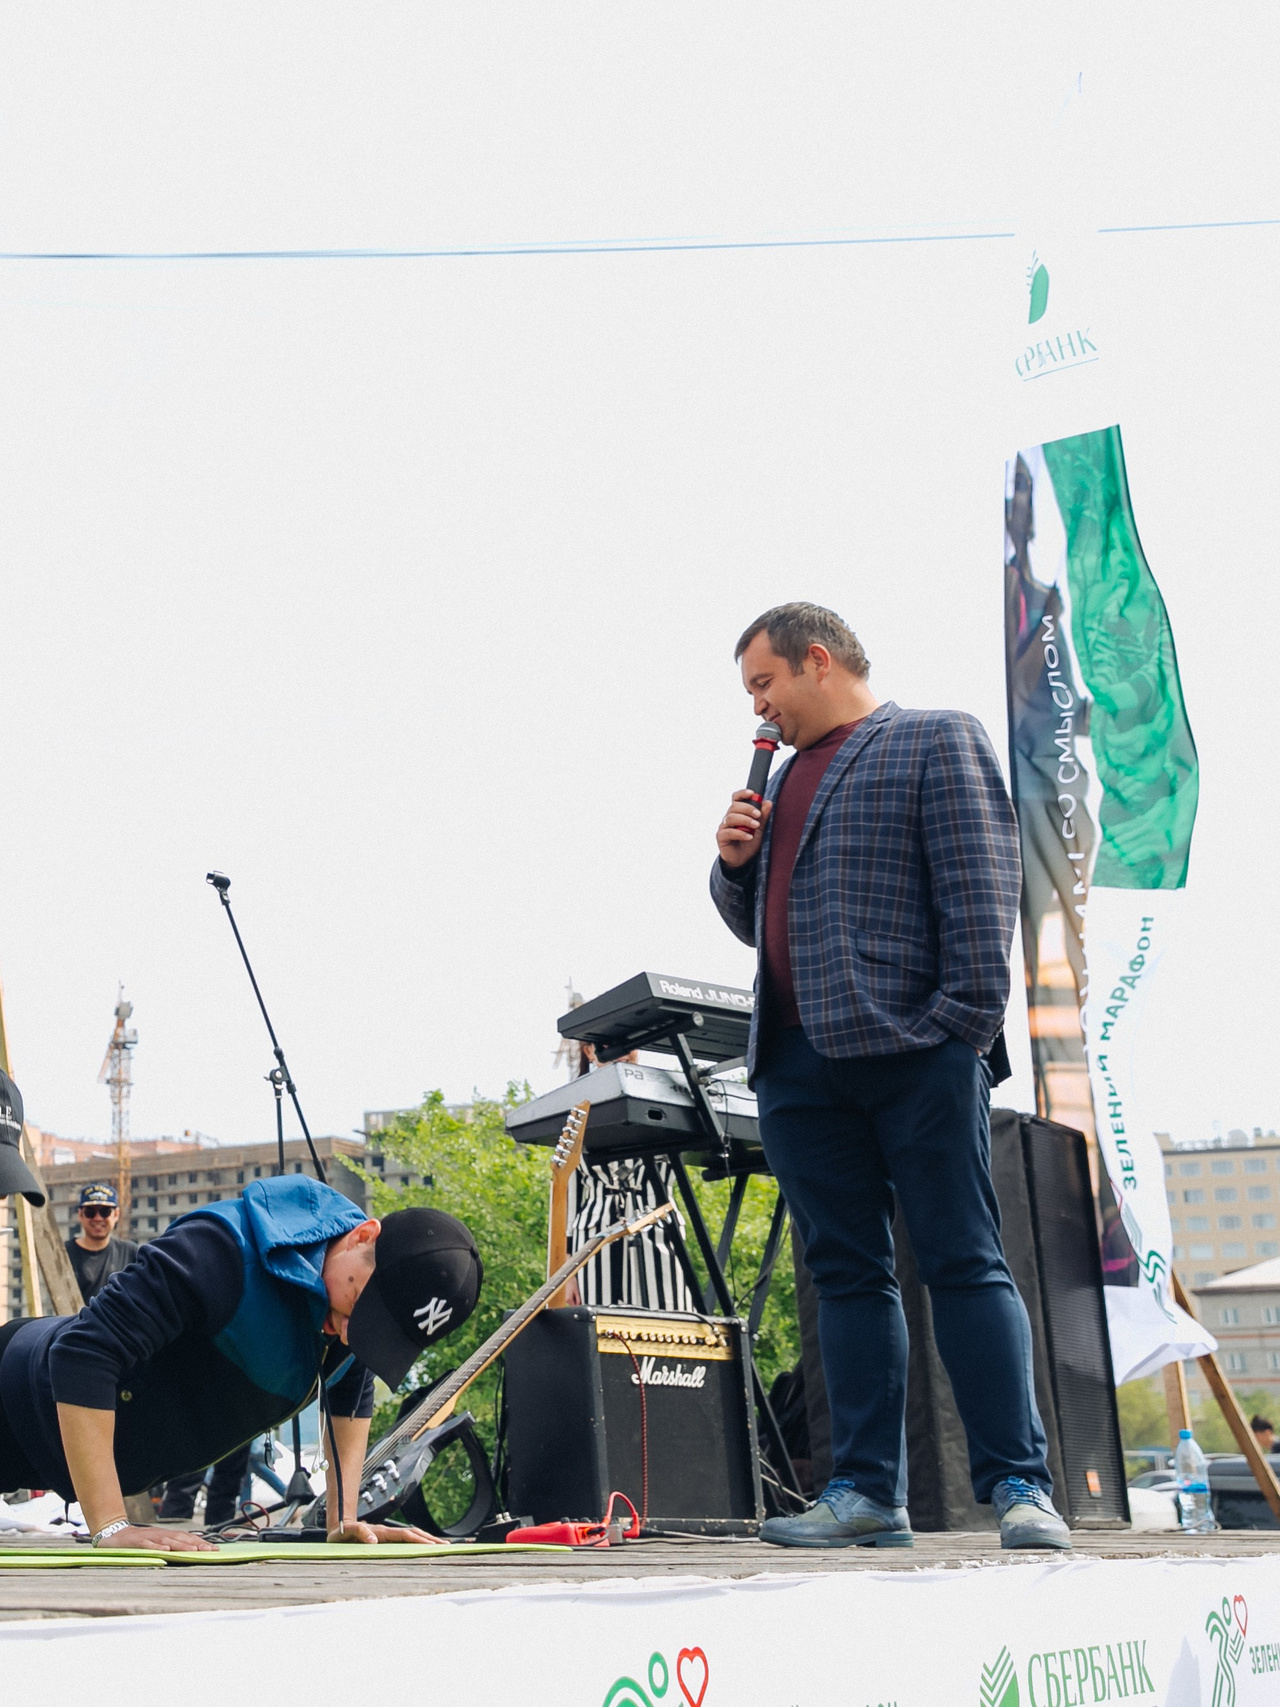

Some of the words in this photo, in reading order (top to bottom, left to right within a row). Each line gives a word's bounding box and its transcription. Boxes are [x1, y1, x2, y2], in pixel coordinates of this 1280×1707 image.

[1041, 614, 1080, 784] СМЫСЛОМ
[659, 979, 704, 1000] Roland
[1099, 916, 1155, 1041] МАРАФОН
[631, 1356, 707, 1388] Marshall
[1027, 1640, 1155, 1707] СБЕРБАНК
[1249, 1643, 1280, 1675] ЗЕЛЕН
